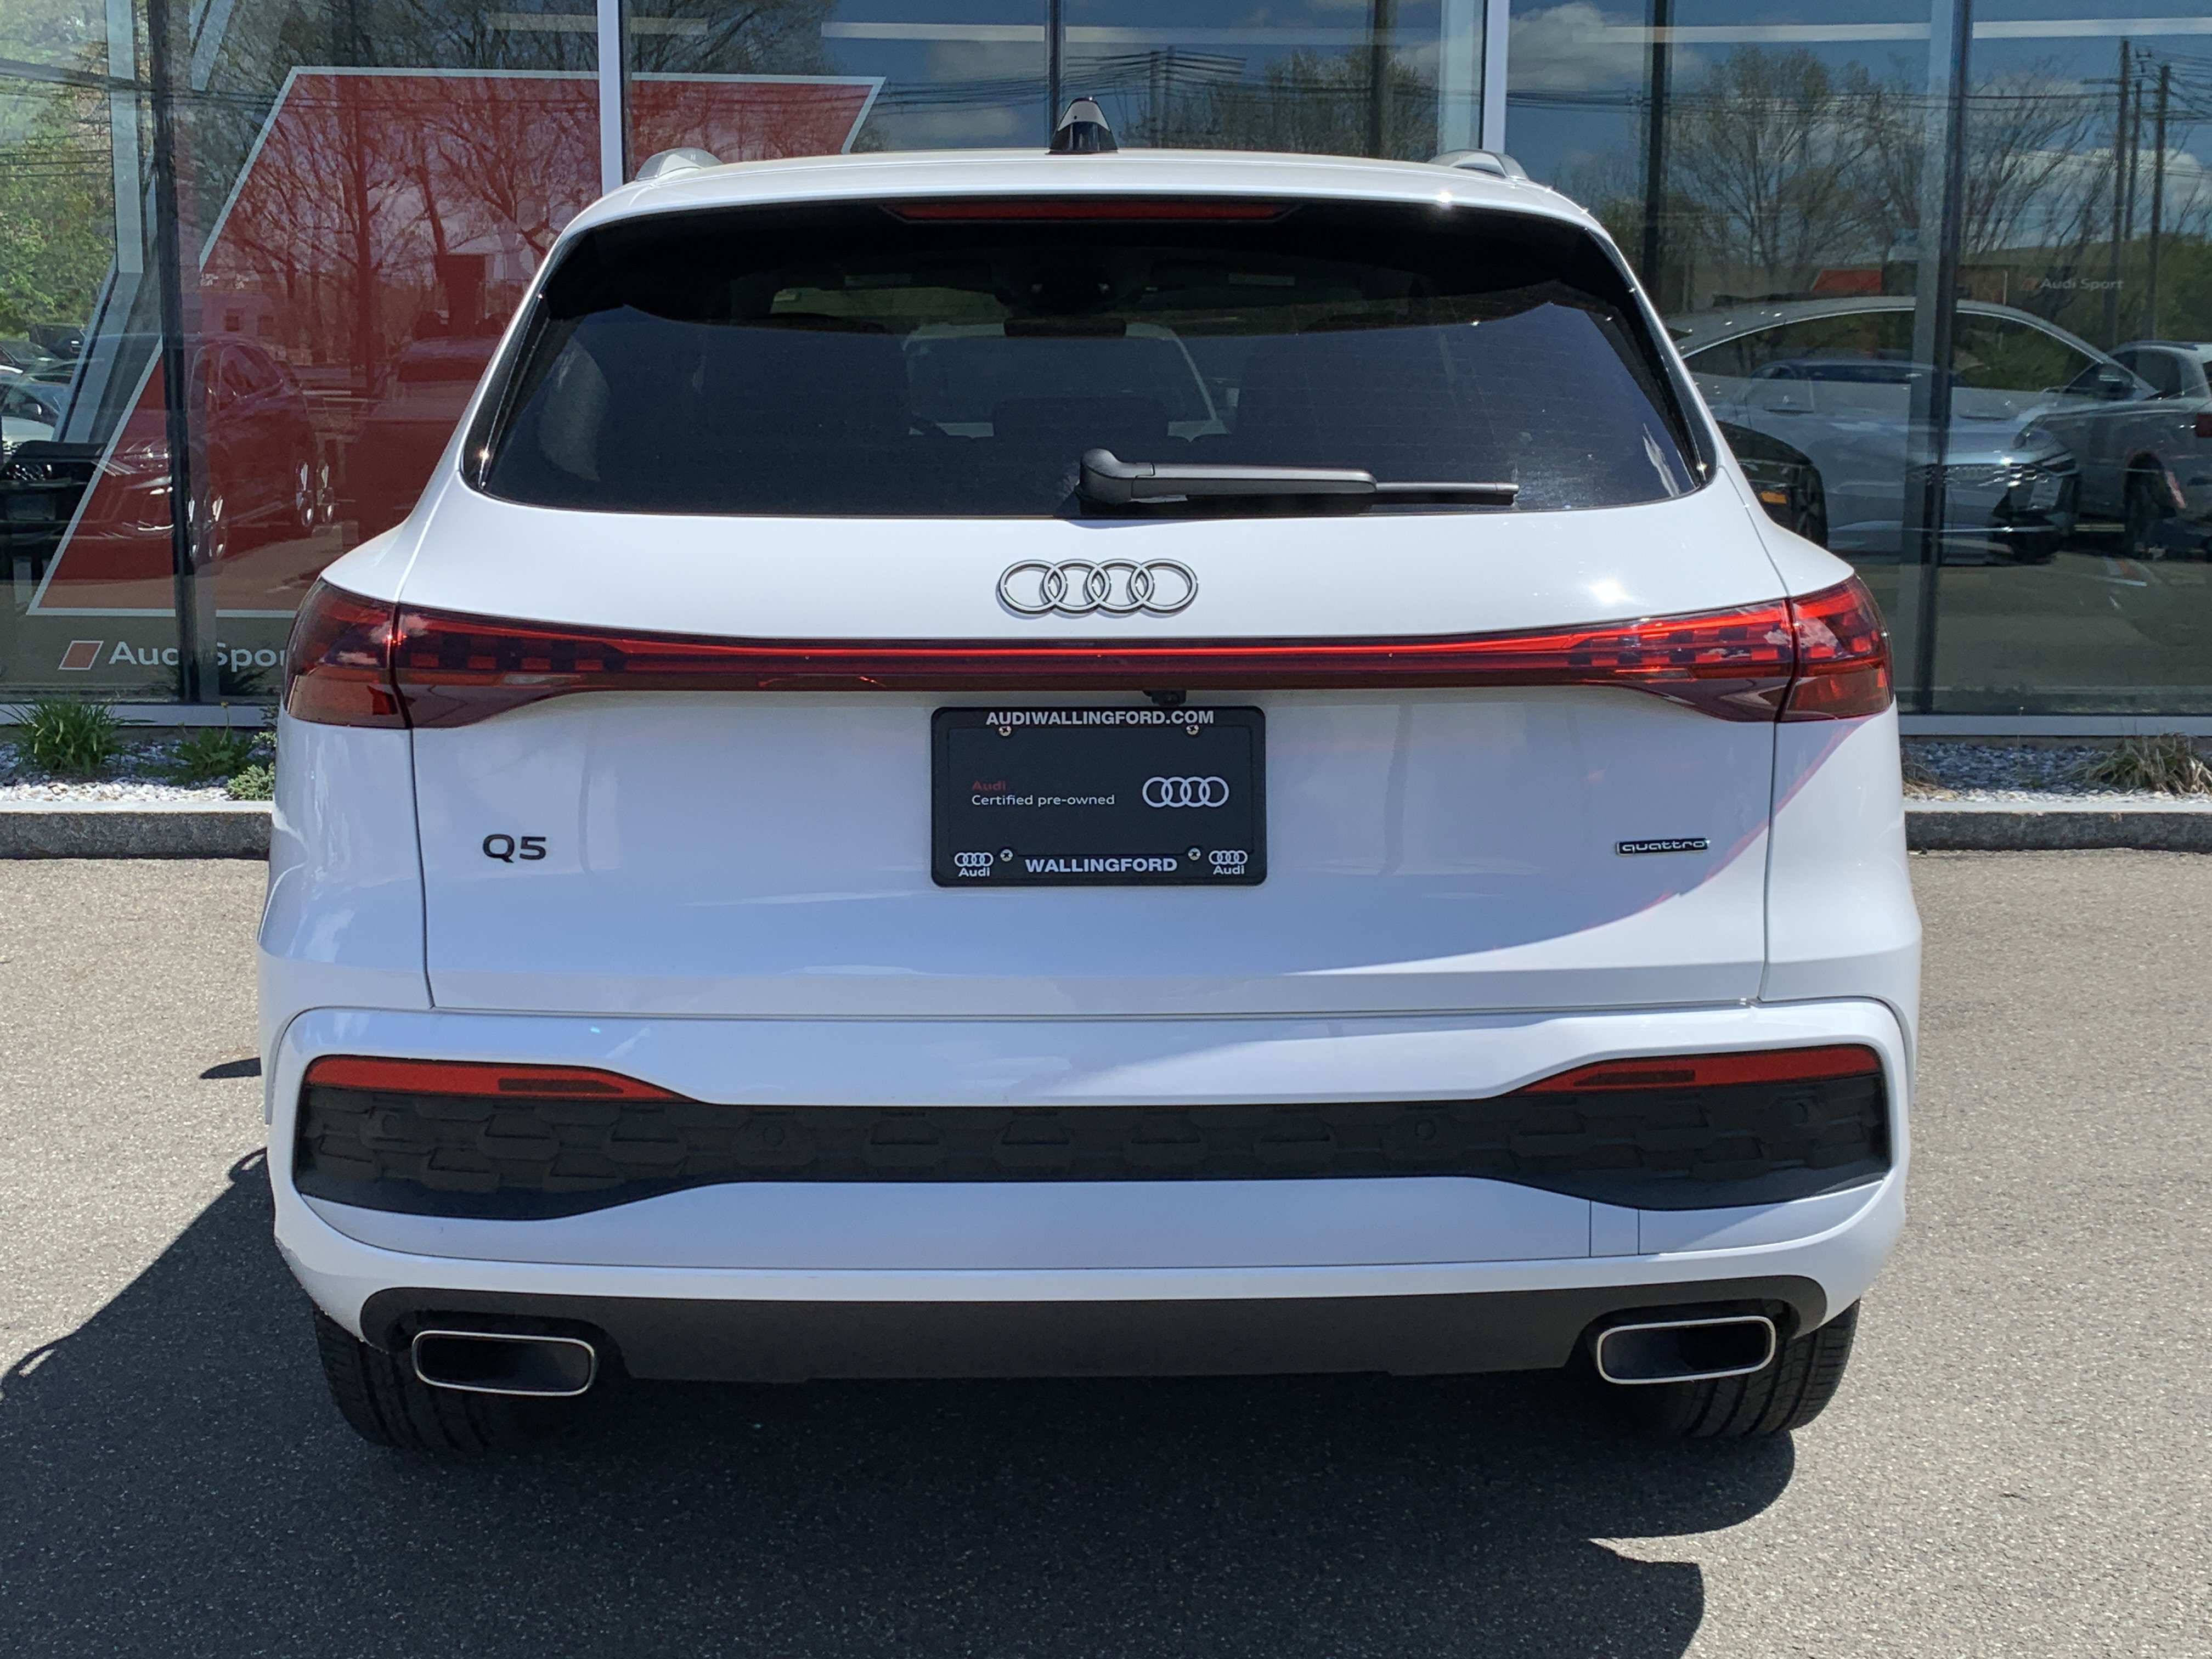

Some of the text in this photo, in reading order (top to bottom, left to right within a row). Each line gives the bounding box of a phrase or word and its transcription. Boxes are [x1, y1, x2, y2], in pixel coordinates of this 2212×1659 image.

[2039, 278, 2124, 291] Audi Sport
[109, 641, 286, 673] Aud Spor
[985, 710, 1214, 725] AUDIWALLINGFORD.COM
[972, 781, 1006, 791] Audi
[972, 794, 1115, 807] Certified pre-owned
[482, 834, 546, 863] Q5
[1622, 840, 1705, 854] quattro
[958, 867, 990, 877] Audi
[1025, 858, 1178, 873] WALLINGFORD
[1213, 865, 1245, 875] Audi
